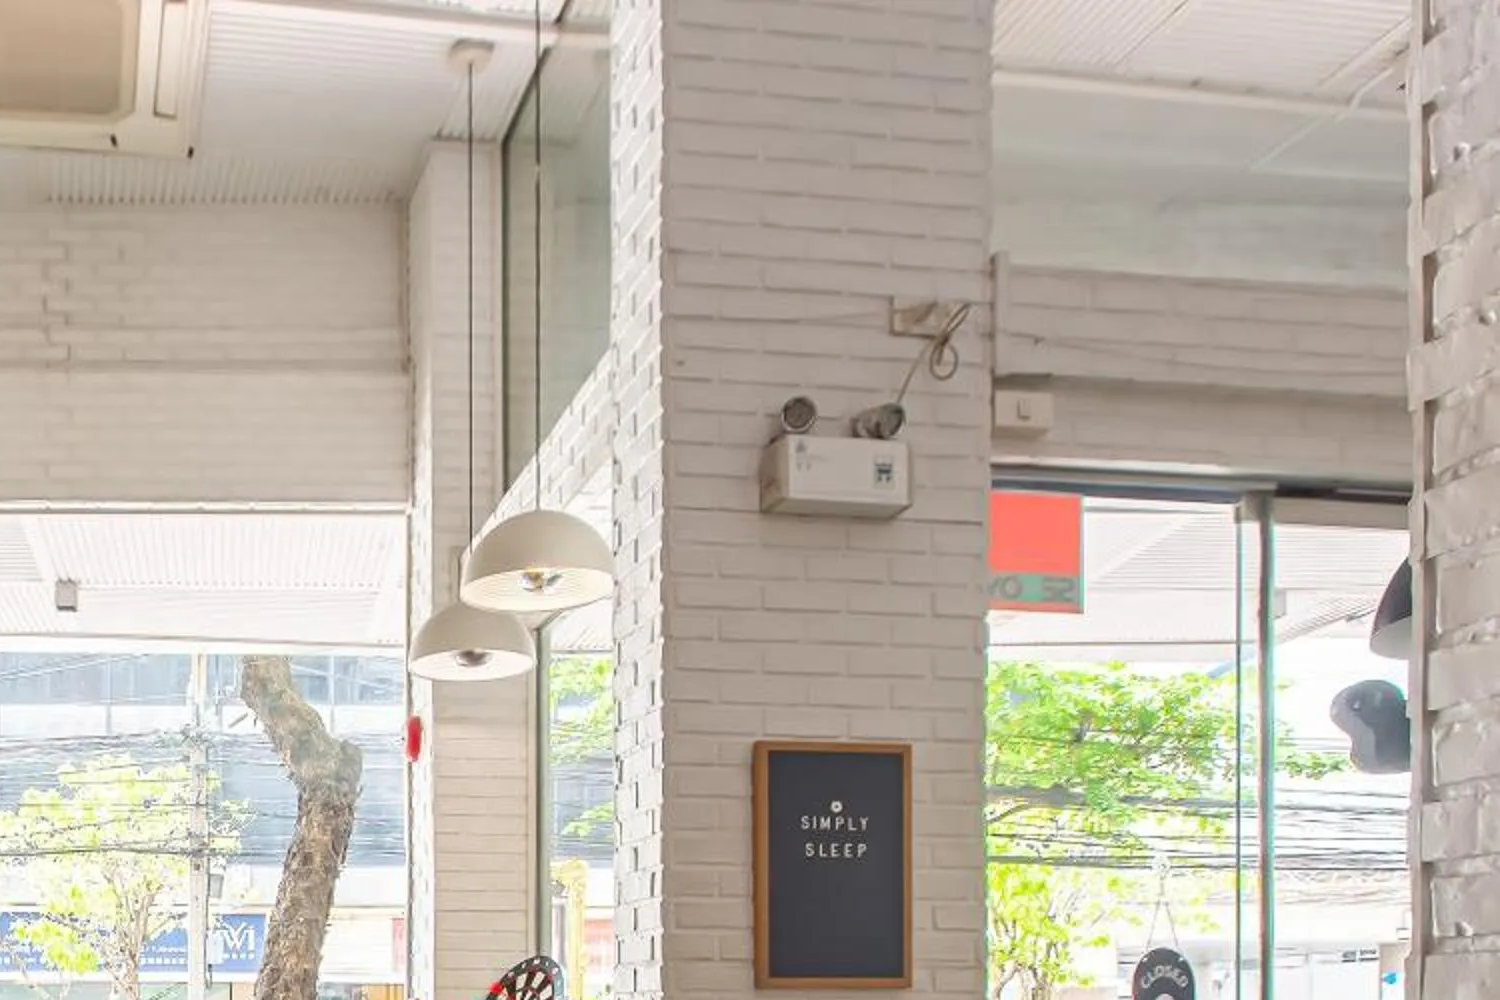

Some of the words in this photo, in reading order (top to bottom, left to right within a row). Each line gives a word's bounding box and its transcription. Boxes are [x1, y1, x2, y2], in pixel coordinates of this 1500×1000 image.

[800, 815, 869, 831] SIMPLY
[805, 843, 868, 859] SLEEP
[1141, 965, 1189, 989] CLOSED
